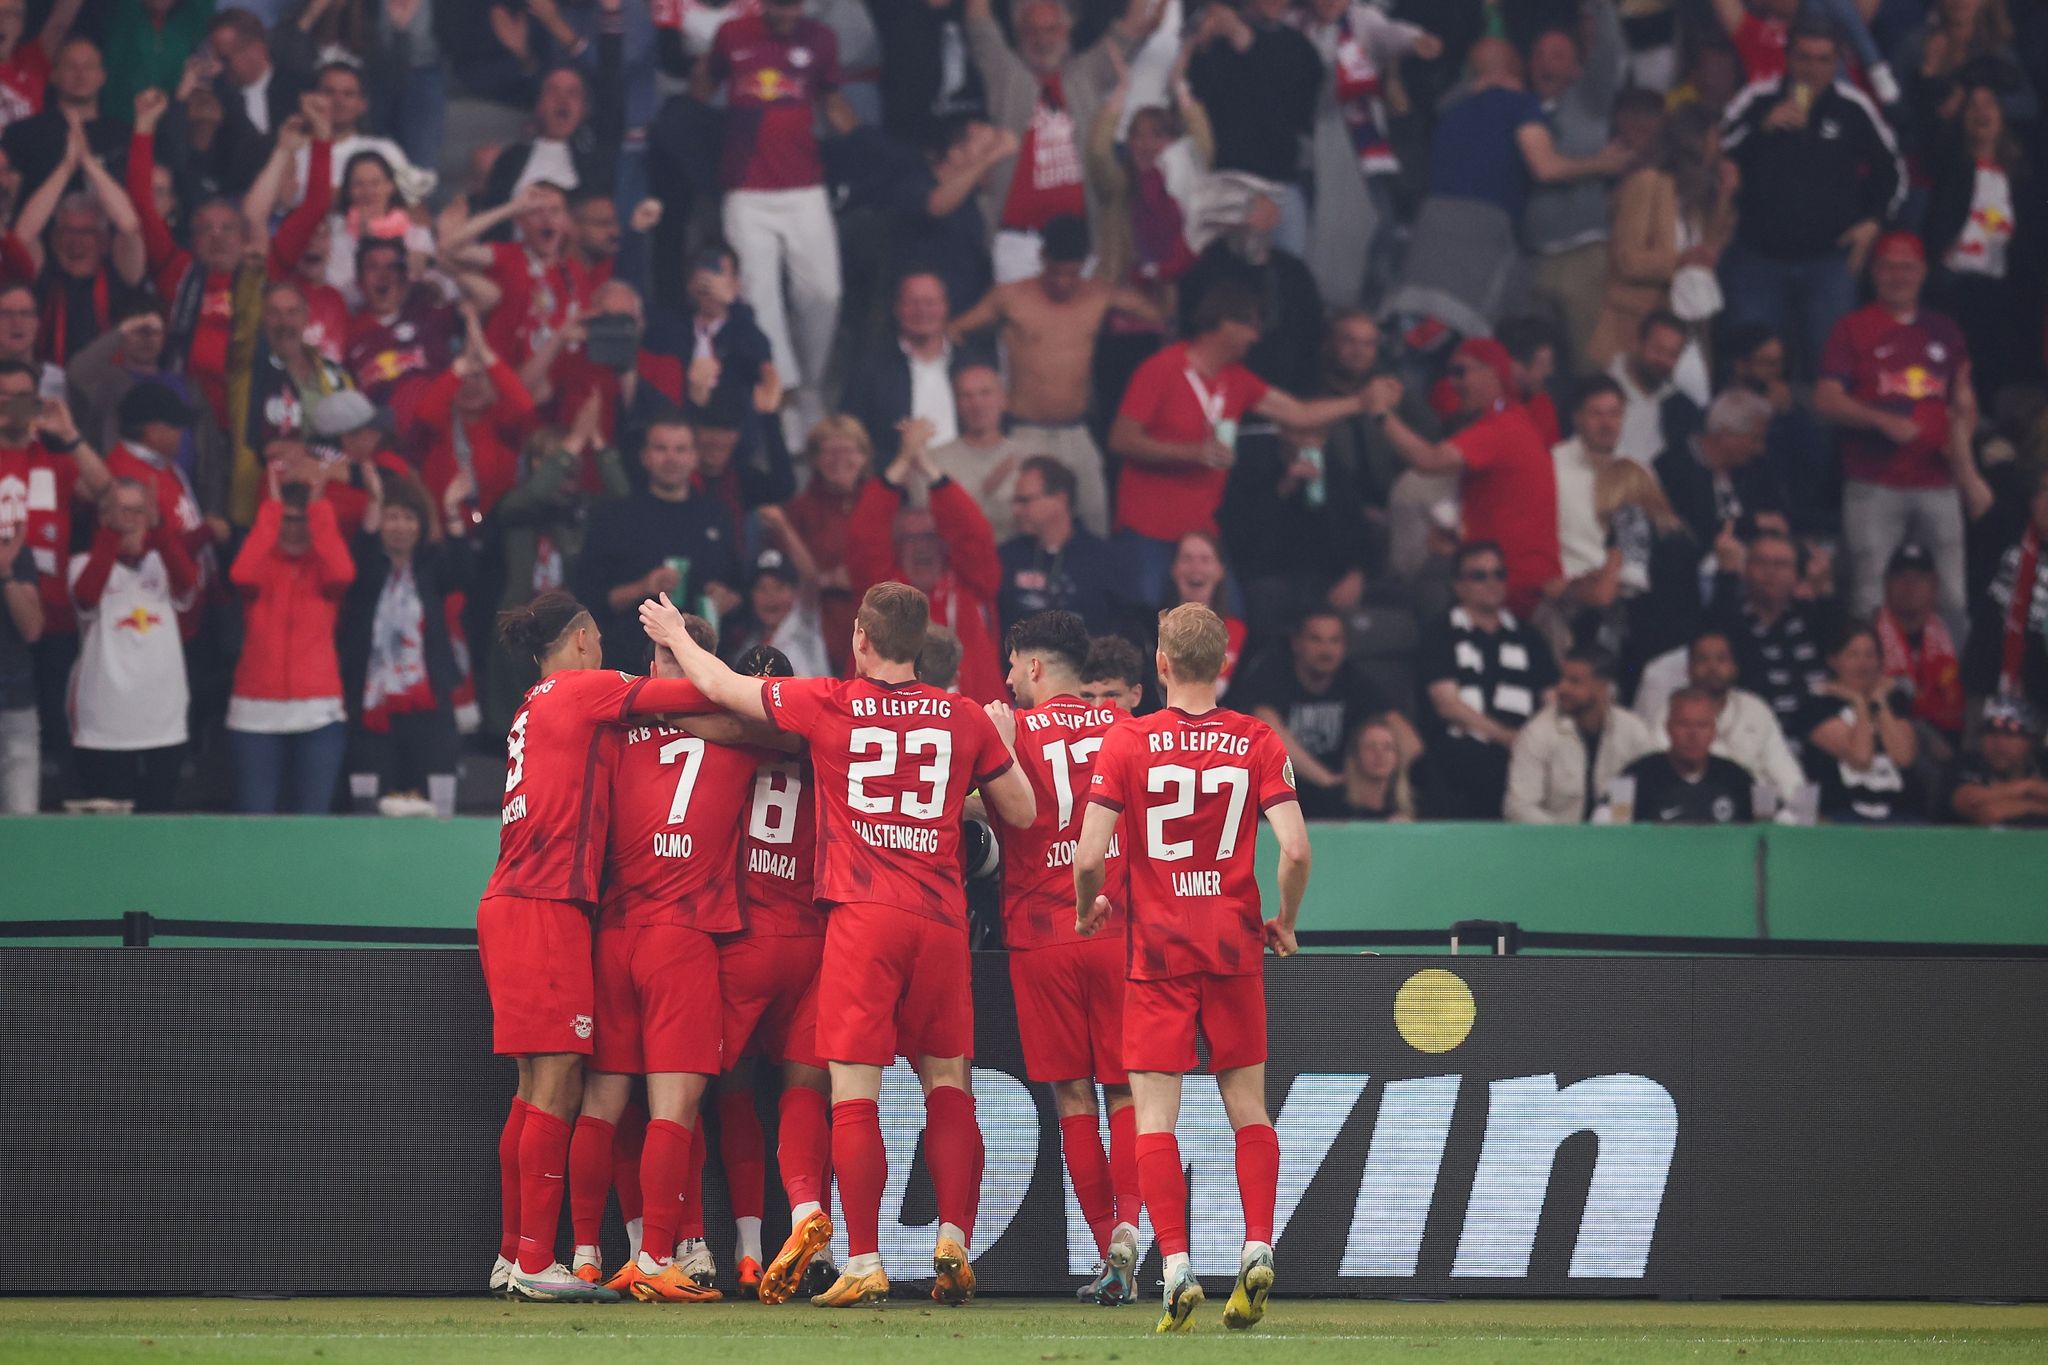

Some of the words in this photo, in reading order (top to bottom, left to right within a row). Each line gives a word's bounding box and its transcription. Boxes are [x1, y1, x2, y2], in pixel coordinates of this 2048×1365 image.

[852, 697, 877, 717] RB
[882, 698, 951, 718] LEIPZIG
[1025, 713, 1051, 732] RB
[1052, 709, 1114, 731] LEIPZIG
[1148, 731, 1174, 753] RB
[1180, 731, 1250, 756] LEIPZIG
[659, 737, 705, 825] 7
[847, 726, 952, 820] 23
[749, 760, 801, 843] 8
[1147, 764, 1249, 862] 27
[653, 832, 692, 859] OLMO
[748, 847, 796, 881] AIDARA
[1172, 870, 1221, 897] LAIMER
